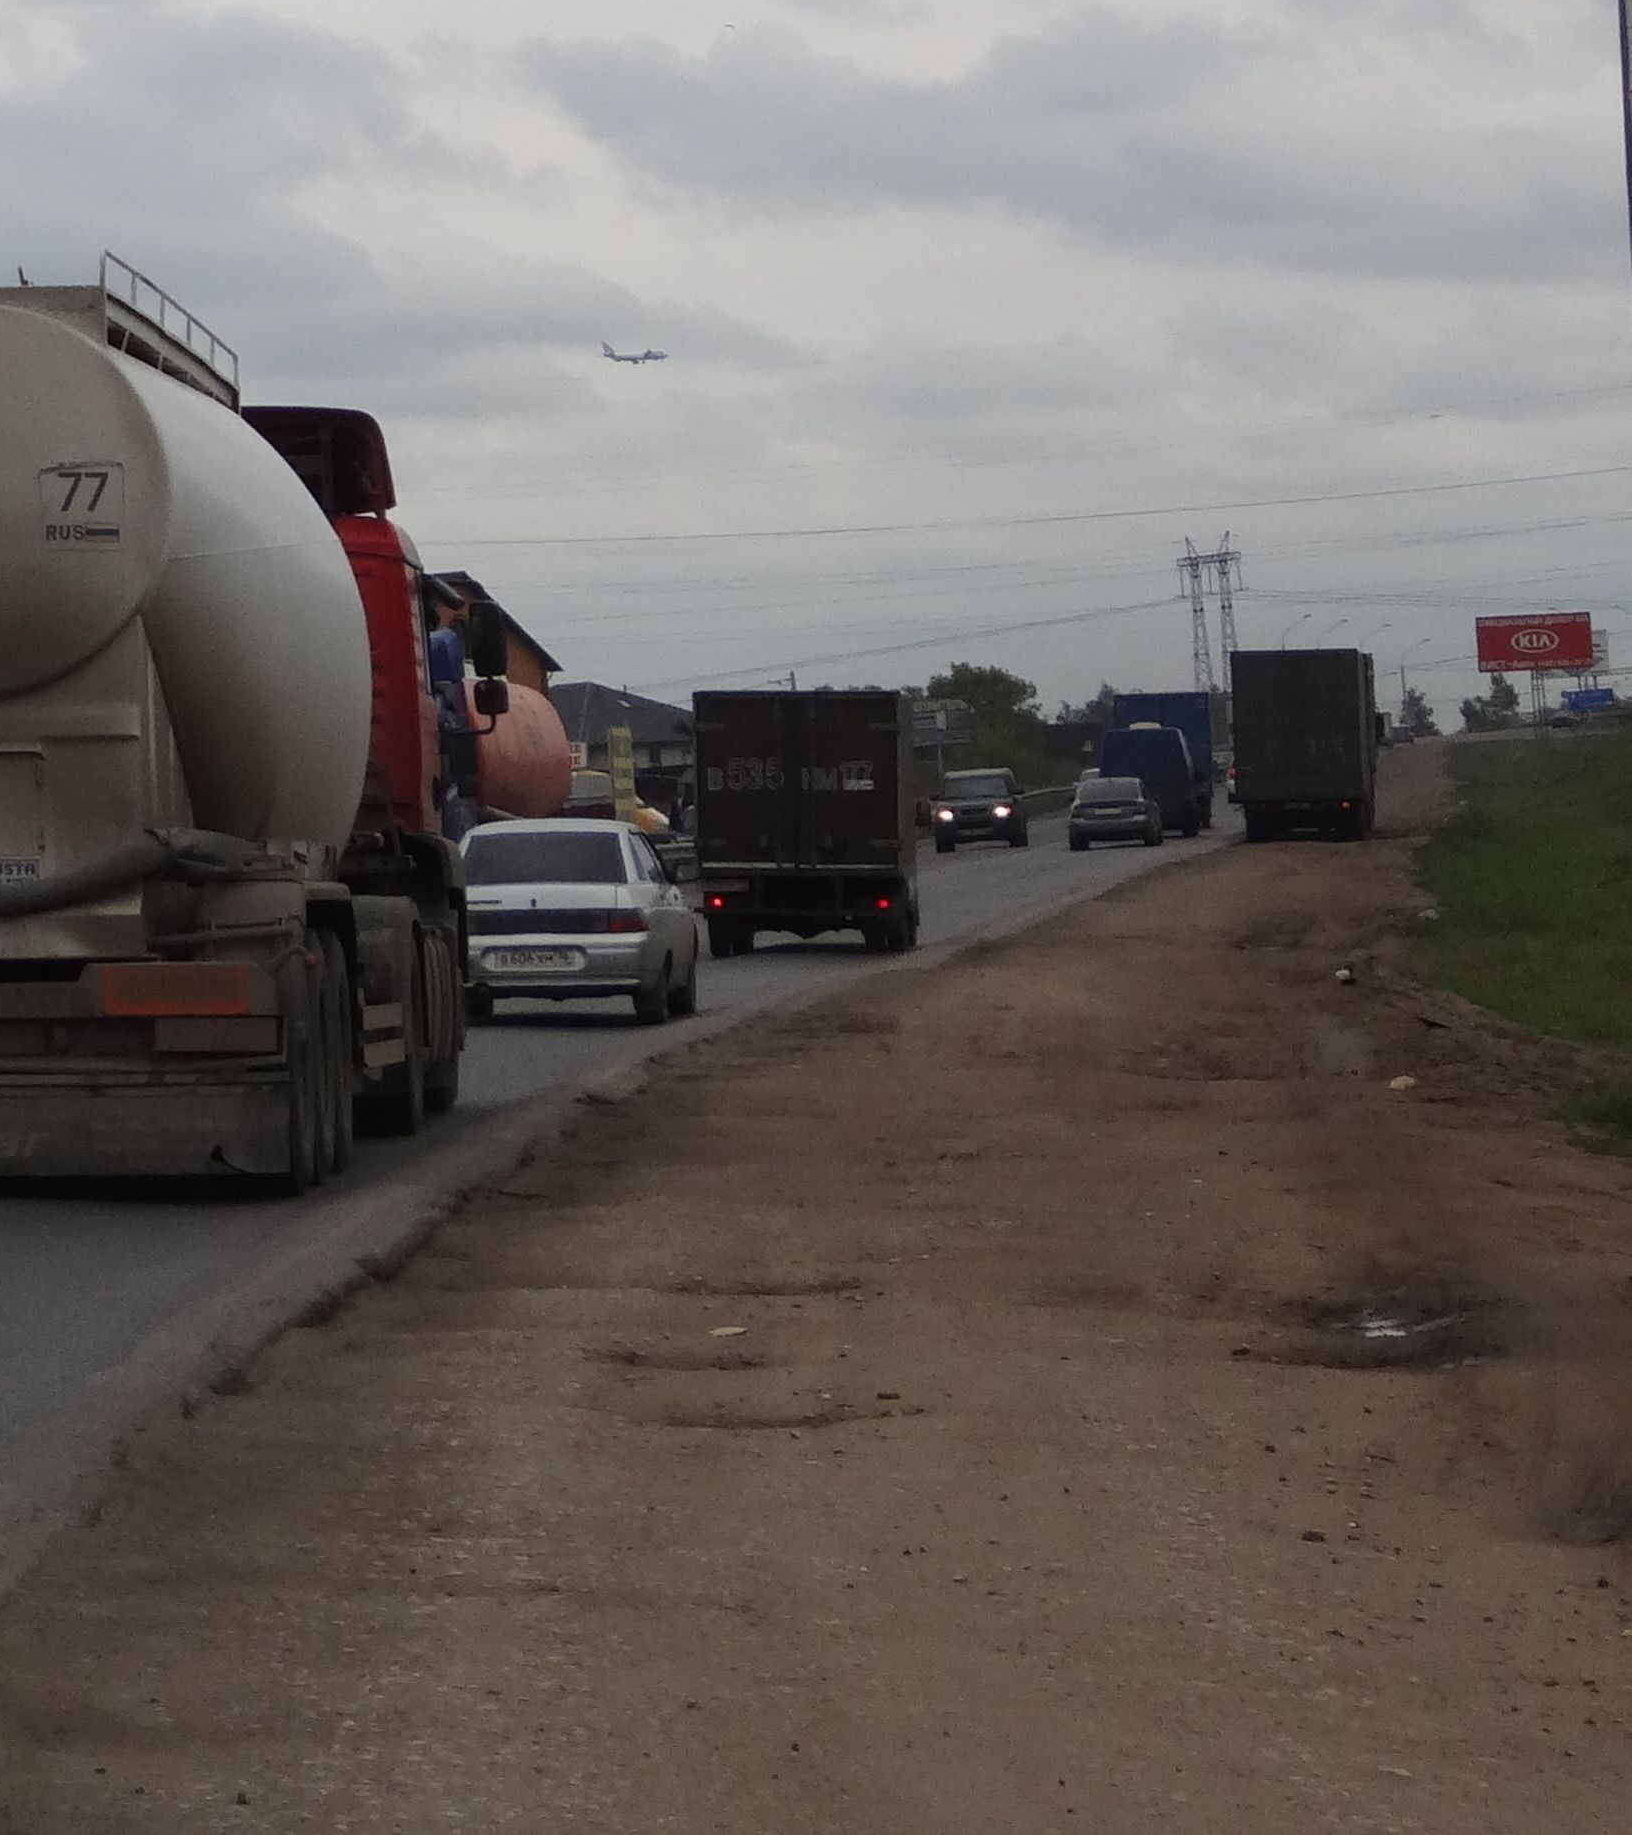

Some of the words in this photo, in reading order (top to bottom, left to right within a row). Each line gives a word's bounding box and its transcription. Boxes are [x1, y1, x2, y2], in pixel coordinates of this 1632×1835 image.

[58, 472, 108, 511] 77
[46, 524, 84, 540] RUS
[1520, 634, 1552, 649] KIA
